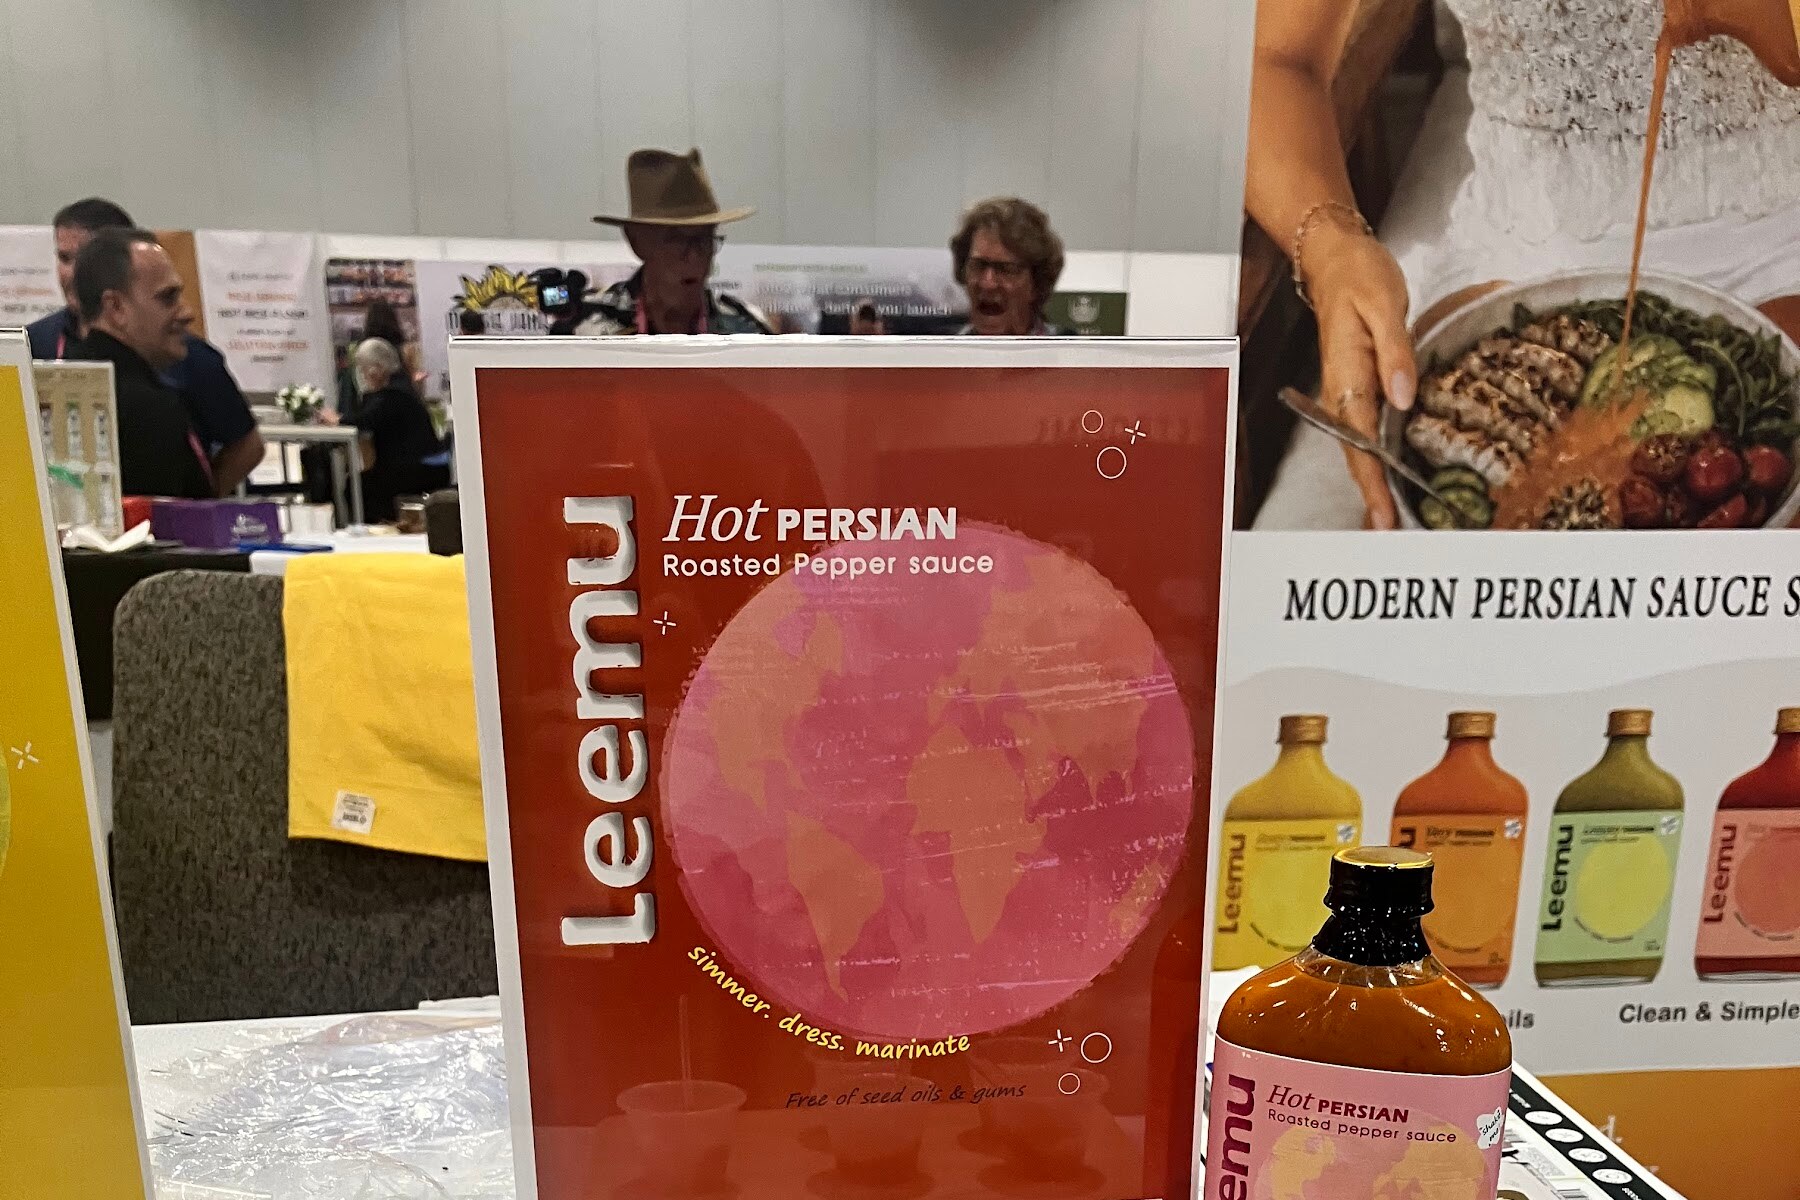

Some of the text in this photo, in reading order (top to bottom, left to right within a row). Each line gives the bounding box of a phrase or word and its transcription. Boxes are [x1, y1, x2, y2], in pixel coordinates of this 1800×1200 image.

[661, 494, 957, 542] Hot PERSIAN
[662, 551, 994, 580] Roasted Pepper sauce
[1284, 577, 1459, 621] MODERN
[1471, 576, 1637, 620] PERSIAN
[1647, 575, 1772, 618] SAUCE
[561, 494, 656, 947] Leemu
[1217, 832, 1247, 934] Leemu
[1541, 824, 1574, 931] Leemu
[1703, 824, 1738, 924] Leemu
[687, 945, 971, 1060] simmer. dress. marinate
[1502, 1008, 1535, 1029] ils
[1618, 999, 1800, 1026] Clean & Simple
[785, 1084, 1027, 1109] Free of seed oils & gums
[1266, 1083, 1410, 1124] Hot PERSIAN
[1267, 1109, 1458, 1144] Roasted pepper sauce
